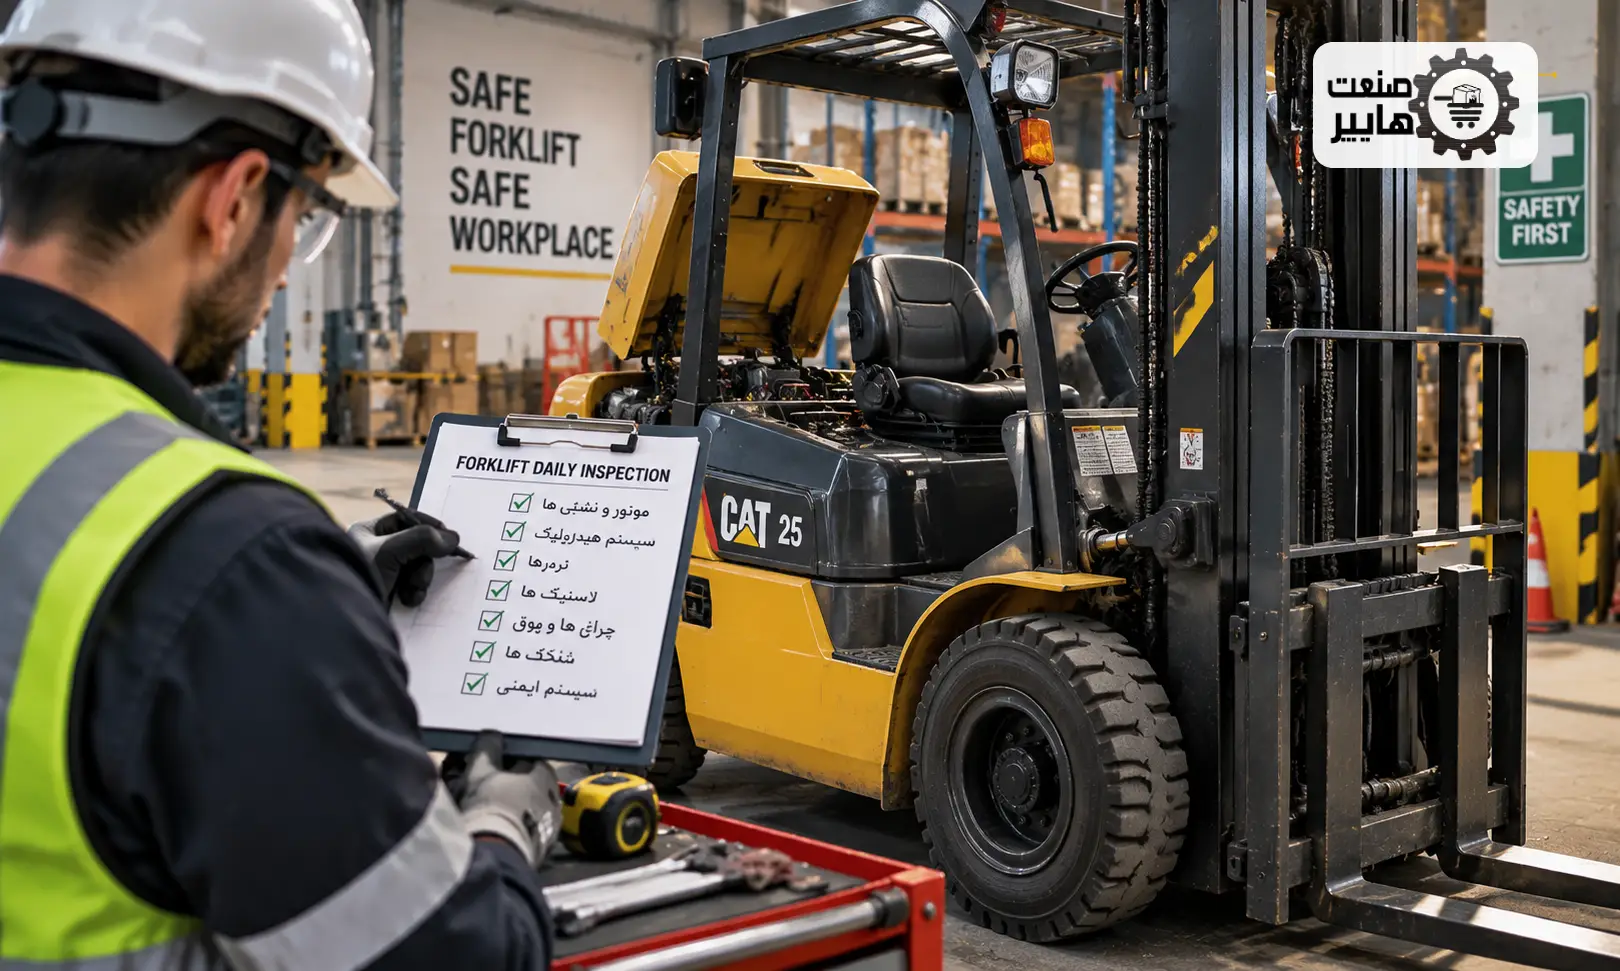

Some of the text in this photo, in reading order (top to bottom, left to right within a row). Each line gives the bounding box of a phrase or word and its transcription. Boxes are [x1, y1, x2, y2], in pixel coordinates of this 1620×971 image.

[449, 66, 532, 116] SAFE
[449, 117, 581, 168] FORKLIFT
[450, 166, 531, 210] SAFE
[1503, 195, 1581, 220] SAFETY
[450, 214, 614, 260] WORKPLACE
[1512, 222, 1572, 246] FIRST
[455, 456, 671, 482] FORKLIFT DAILY INSPECTION
[542, 497, 557, 510] ها
[601, 506, 610, 518] و
[721, 494, 802, 548] CAT 25
[520, 584, 536, 598] ها
[545, 622, 556, 635] و
[560, 617, 576, 632] ها
[505, 645, 522, 659] ها
[496, 679, 540, 698] ایمنی
